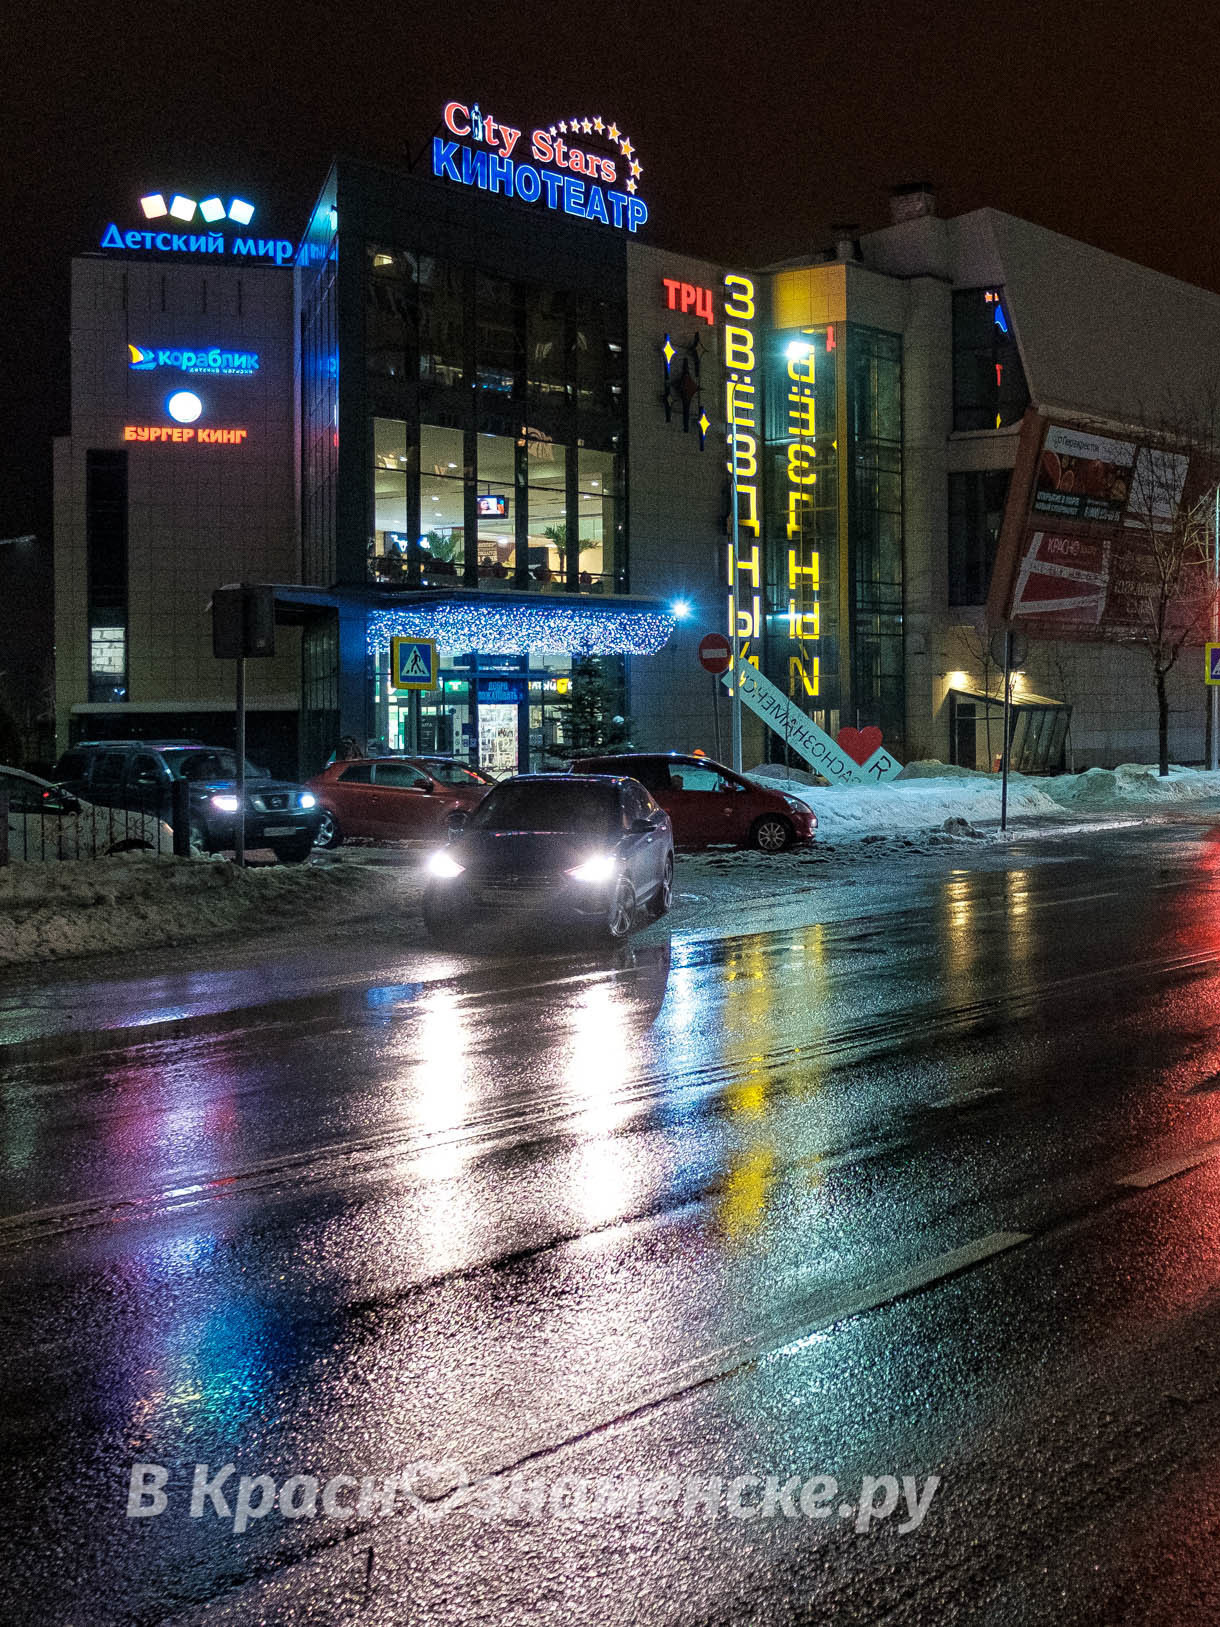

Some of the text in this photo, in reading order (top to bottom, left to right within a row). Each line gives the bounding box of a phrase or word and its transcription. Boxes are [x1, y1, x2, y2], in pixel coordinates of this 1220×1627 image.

[443, 102, 618, 184] City Stars
[433, 136, 649, 233] КИНОТЕАТР
[101, 221, 225, 255] Детский
[232, 236, 294, 265] мир
[662, 277, 715, 326] ТРЦ
[157, 347, 260, 371] кораблик
[123, 426, 248, 445] БУРГЕР КИНГ
